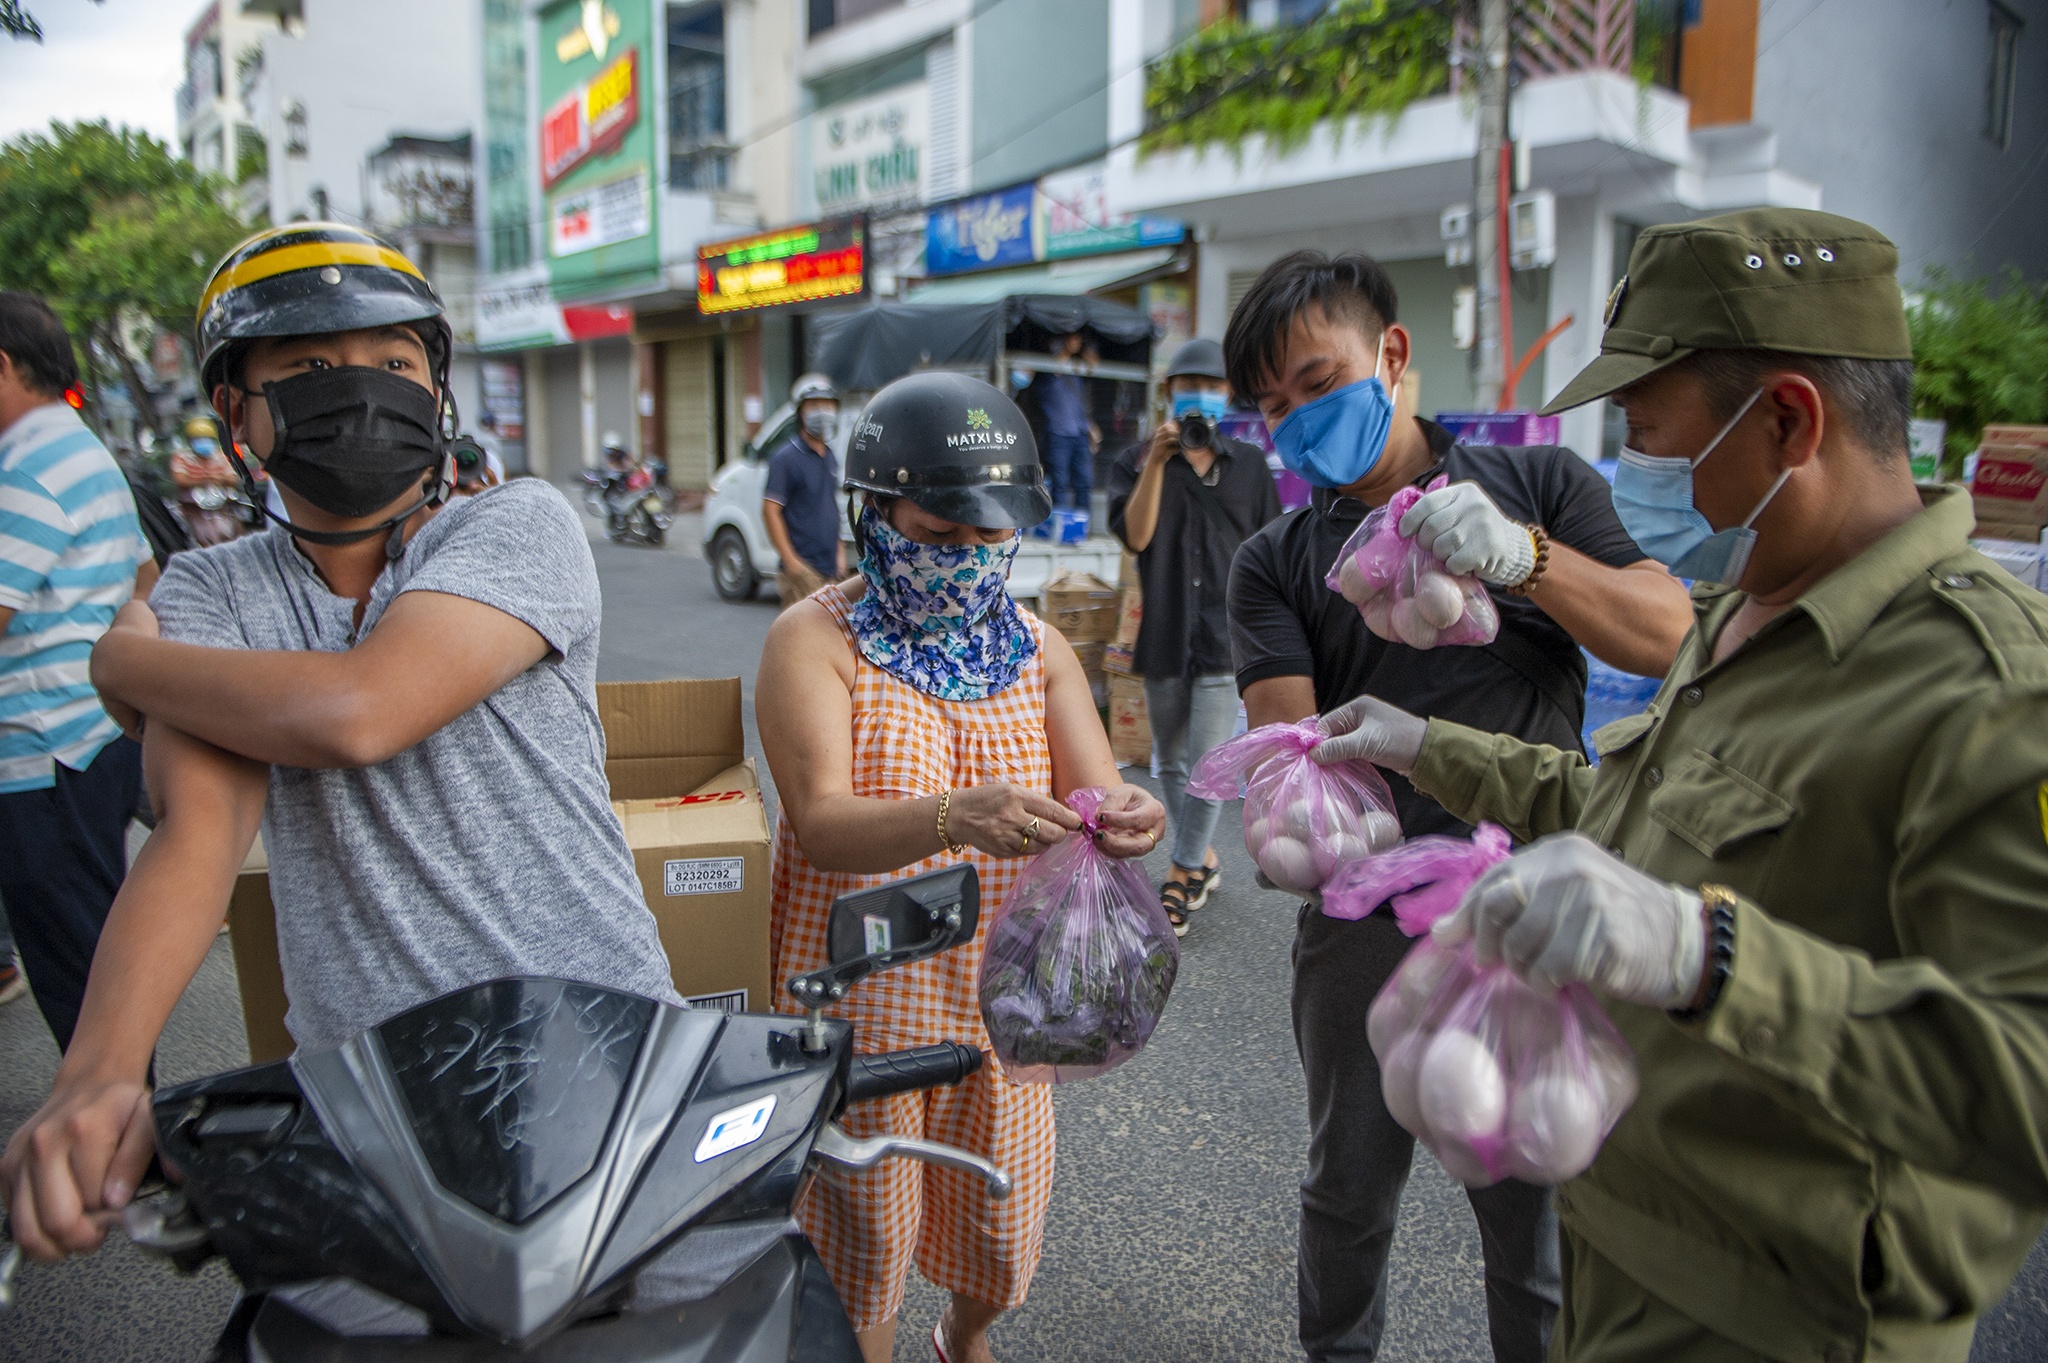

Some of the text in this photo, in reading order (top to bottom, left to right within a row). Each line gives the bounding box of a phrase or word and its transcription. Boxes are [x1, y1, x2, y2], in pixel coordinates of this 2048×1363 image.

[946, 432, 991, 448] MATXI
[676, 870, 729, 881] 82320292
[669, 880, 738, 892] LOT 0147C185B7
